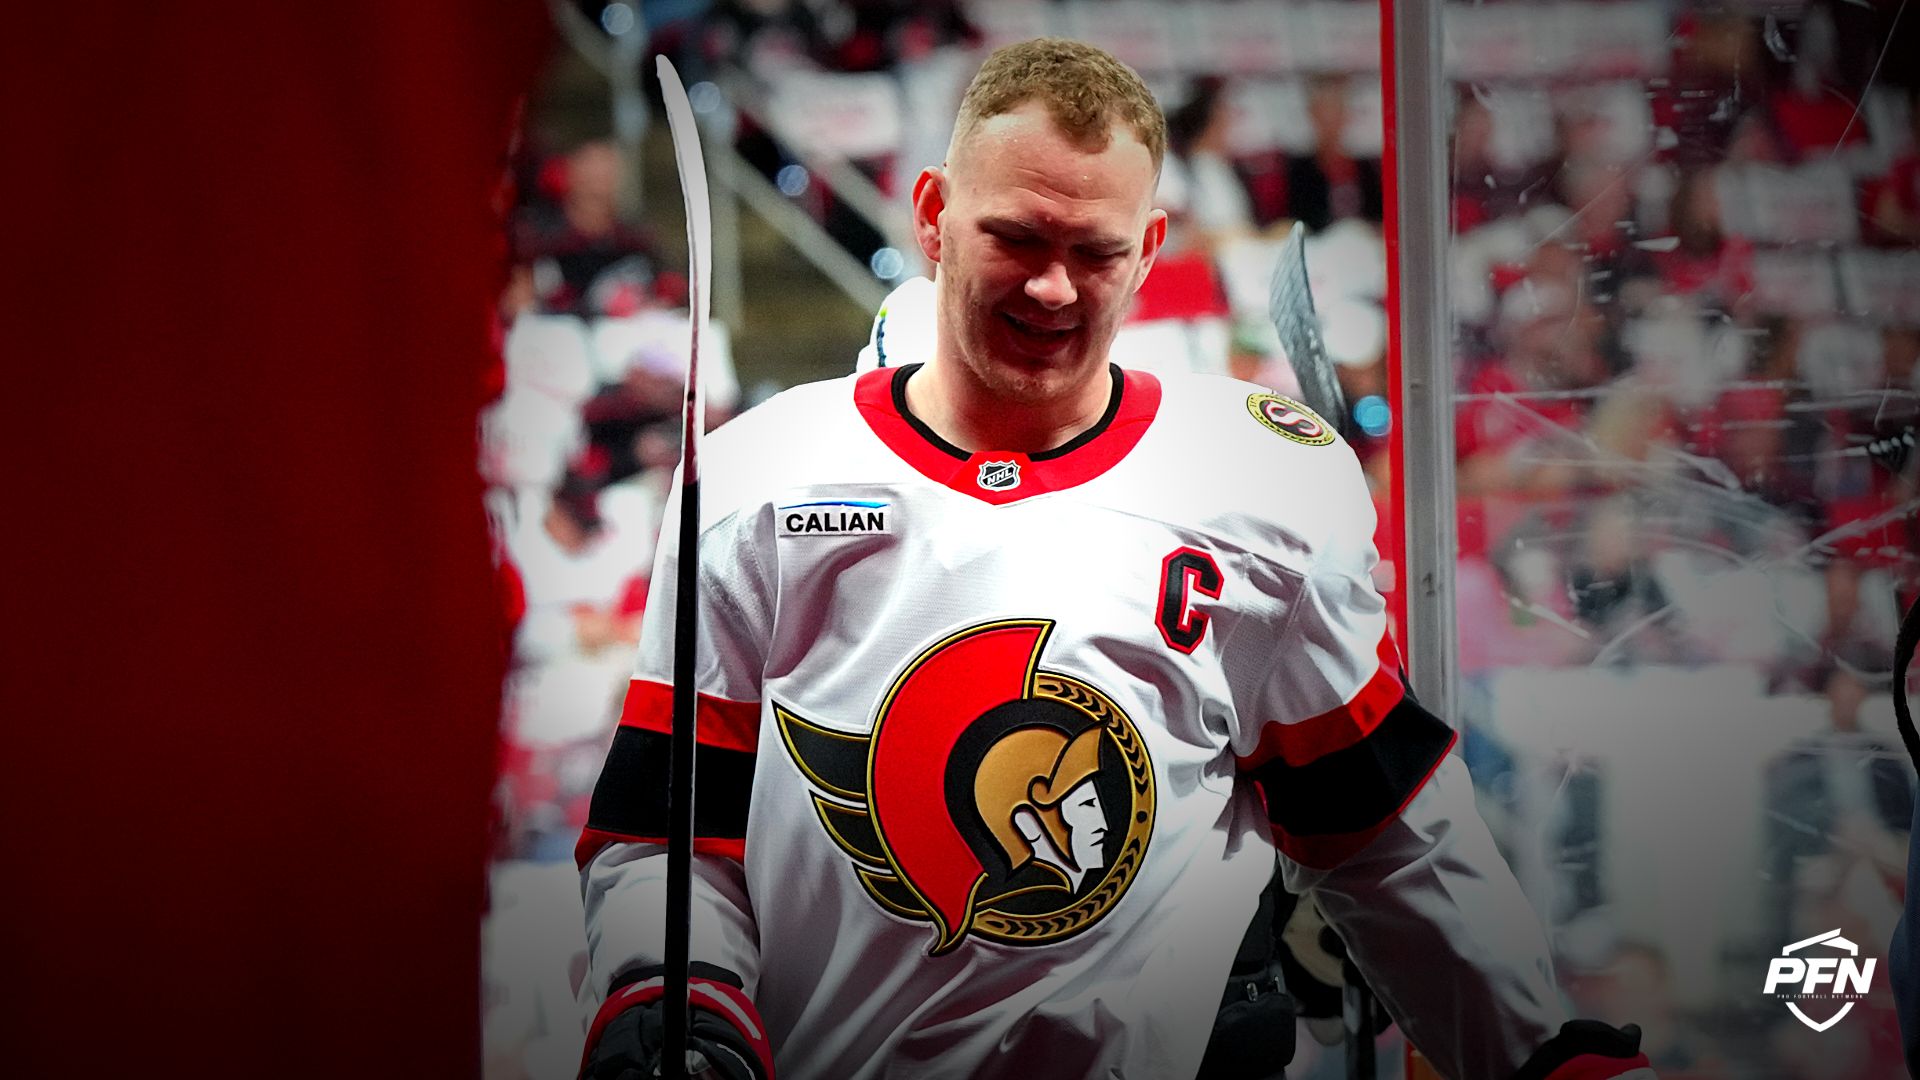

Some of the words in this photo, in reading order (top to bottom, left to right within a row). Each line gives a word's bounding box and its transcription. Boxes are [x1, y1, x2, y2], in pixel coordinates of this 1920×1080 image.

[1264, 399, 1323, 438] S
[987, 469, 1012, 485] NHL
[786, 512, 884, 532] CALIAN
[1155, 546, 1224, 655] C
